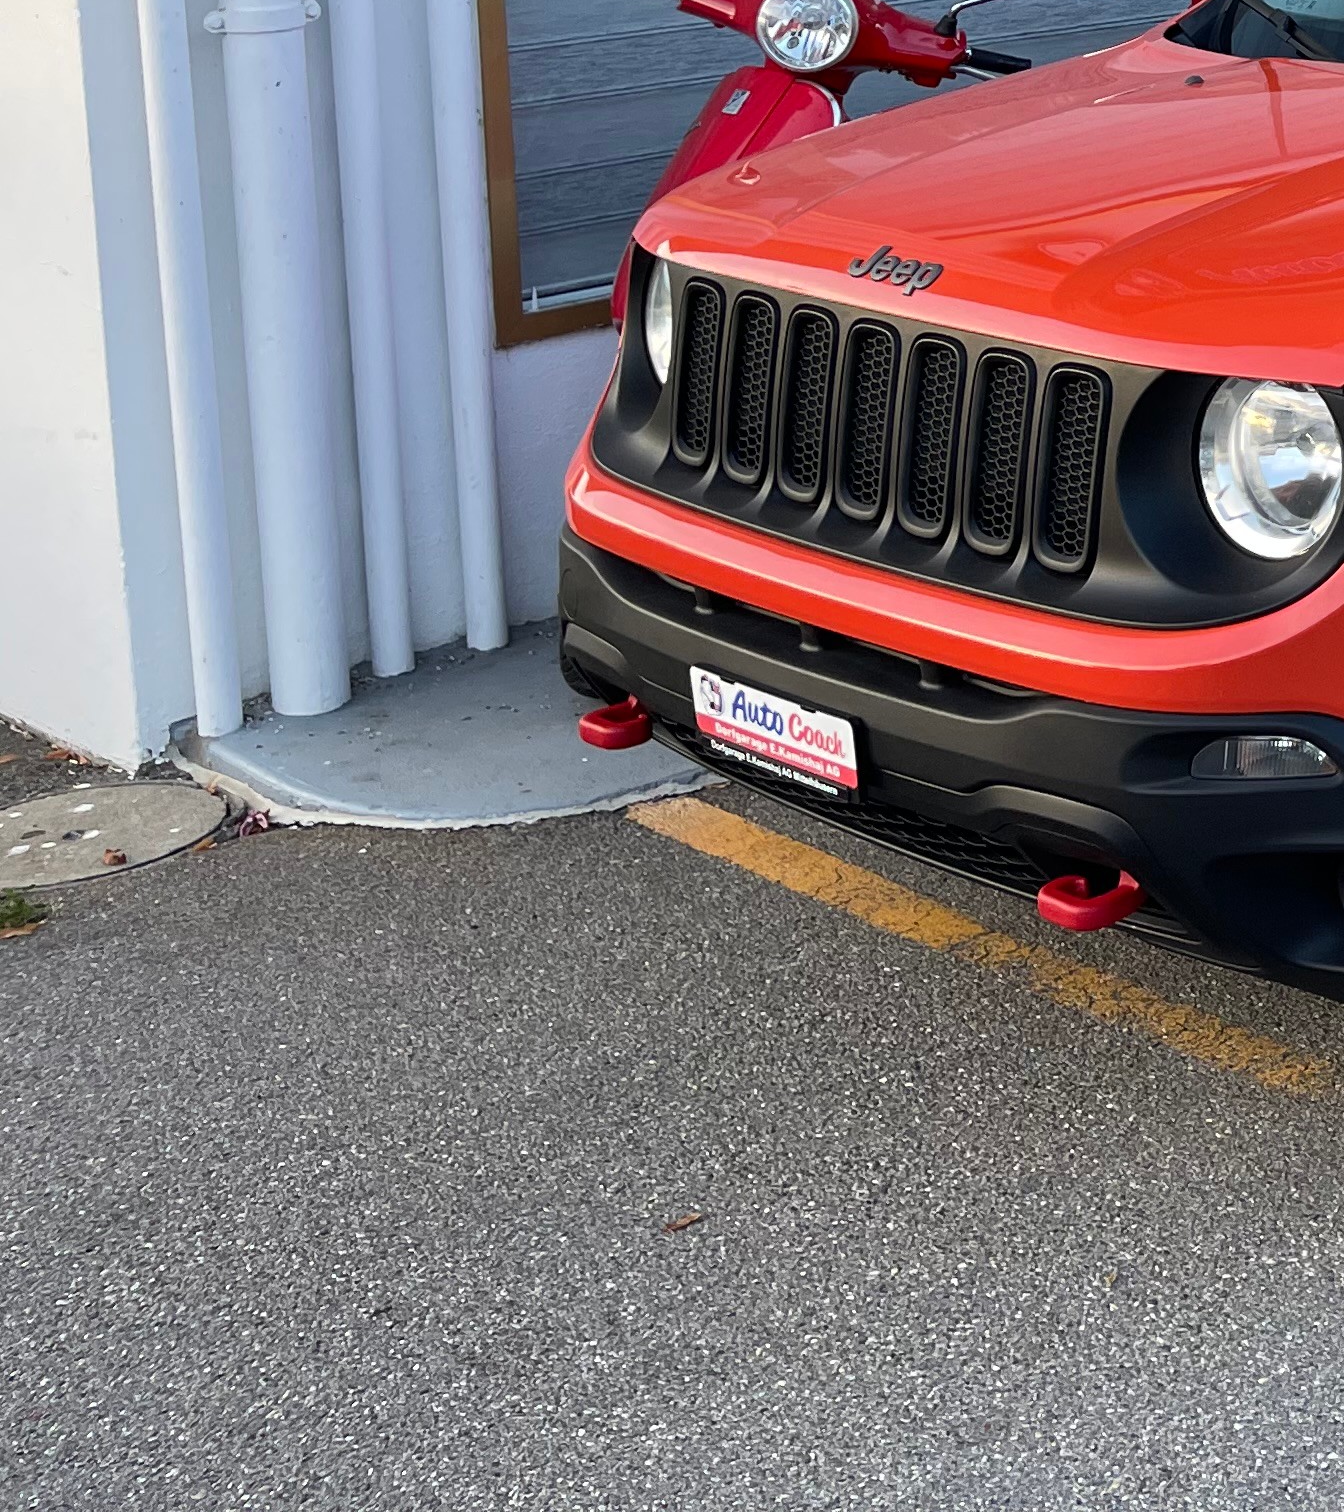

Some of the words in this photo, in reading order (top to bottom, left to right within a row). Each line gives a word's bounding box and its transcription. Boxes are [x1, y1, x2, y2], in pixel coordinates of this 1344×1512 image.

[847, 245, 944, 296] Jeep
[732, 690, 784, 736] Auto
[788, 713, 847, 759] Coach
[825, 762, 841, 778] AG
